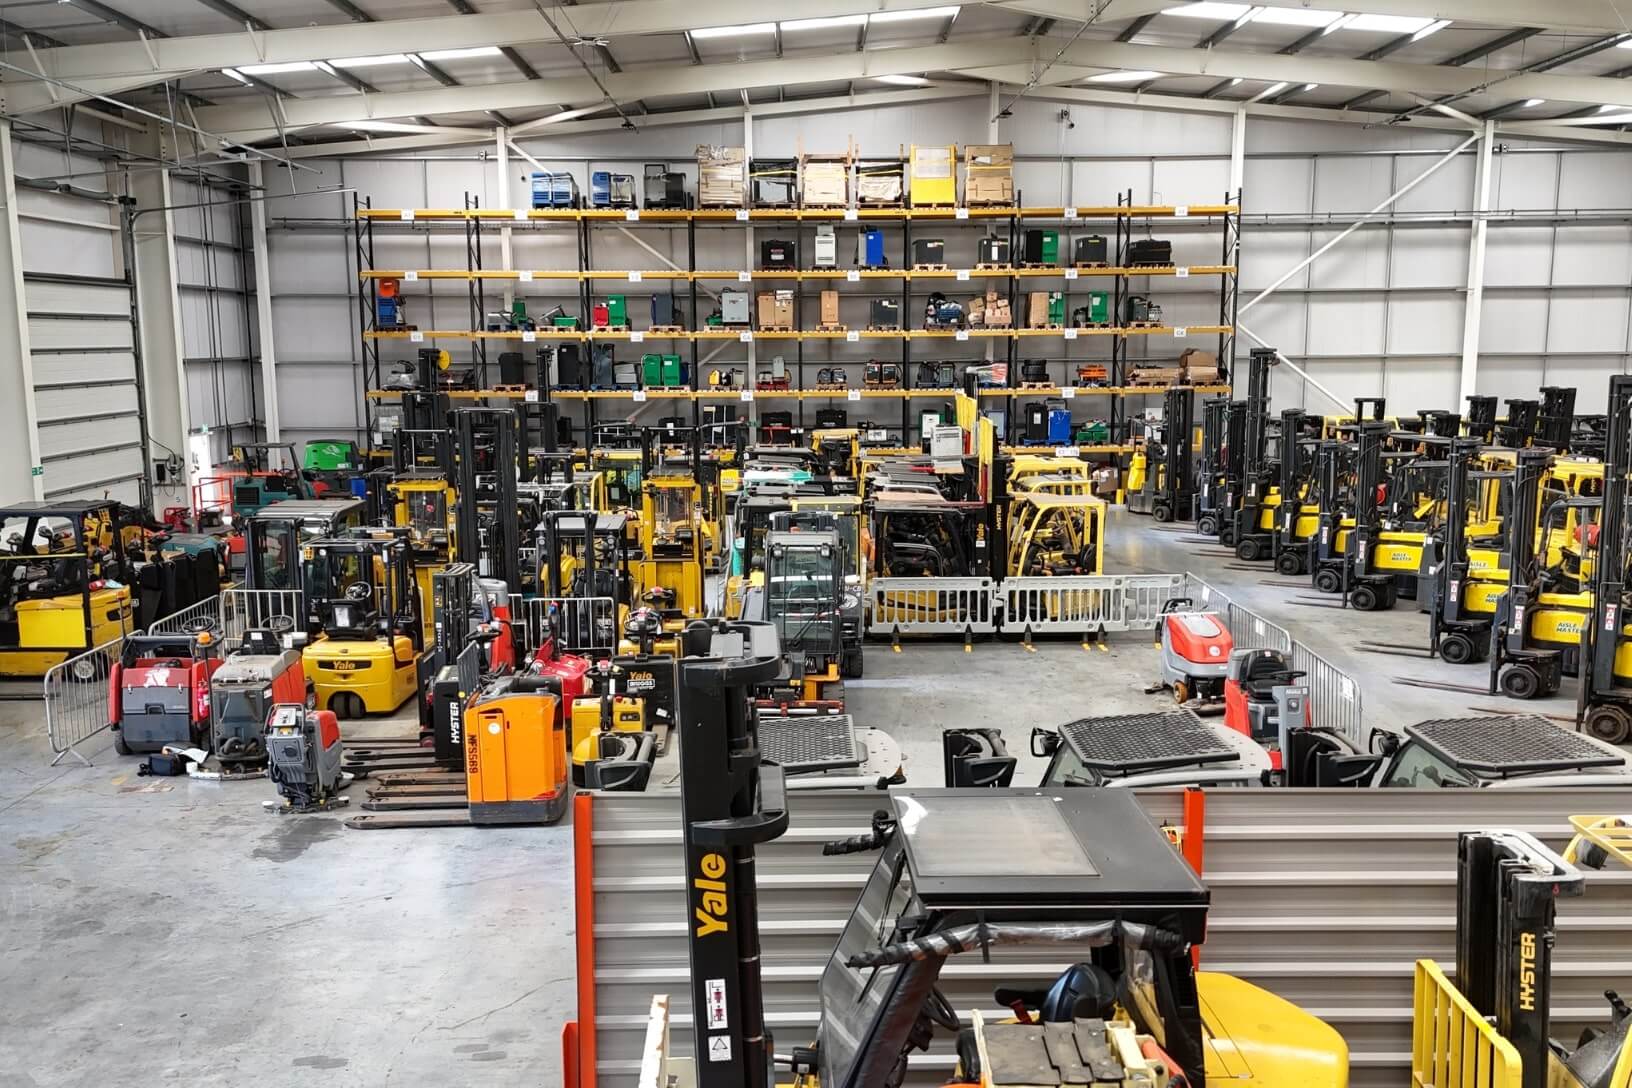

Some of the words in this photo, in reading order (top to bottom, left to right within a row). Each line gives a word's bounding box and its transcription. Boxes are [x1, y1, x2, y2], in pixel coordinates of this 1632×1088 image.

[333, 661, 356, 670] Yale
[630, 671, 653, 680] Yale
[449, 702, 460, 744] HYSTER
[695, 853, 729, 938] Yale
[1520, 932, 1536, 1011] HYSTER
